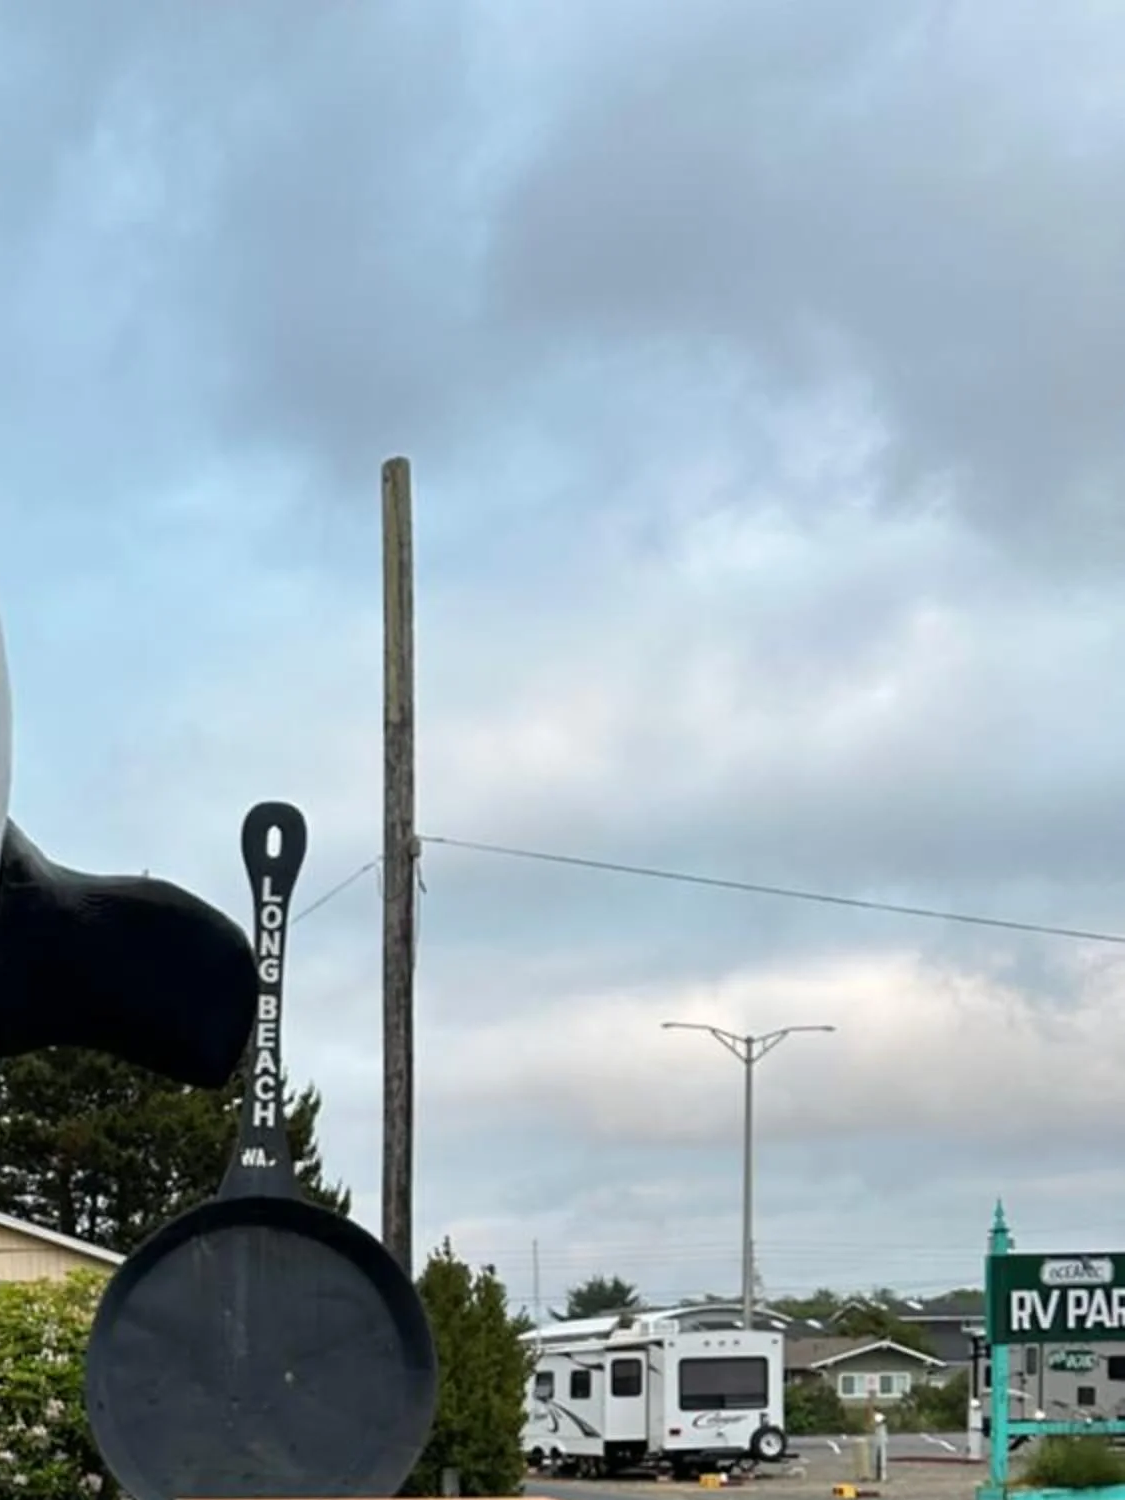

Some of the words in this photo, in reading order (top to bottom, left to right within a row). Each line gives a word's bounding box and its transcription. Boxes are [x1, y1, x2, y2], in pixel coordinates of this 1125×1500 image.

[257, 876, 283, 983] LONG
[253, 995, 276, 1127] BEACH
[1010, 1289, 1061, 1331] RV
